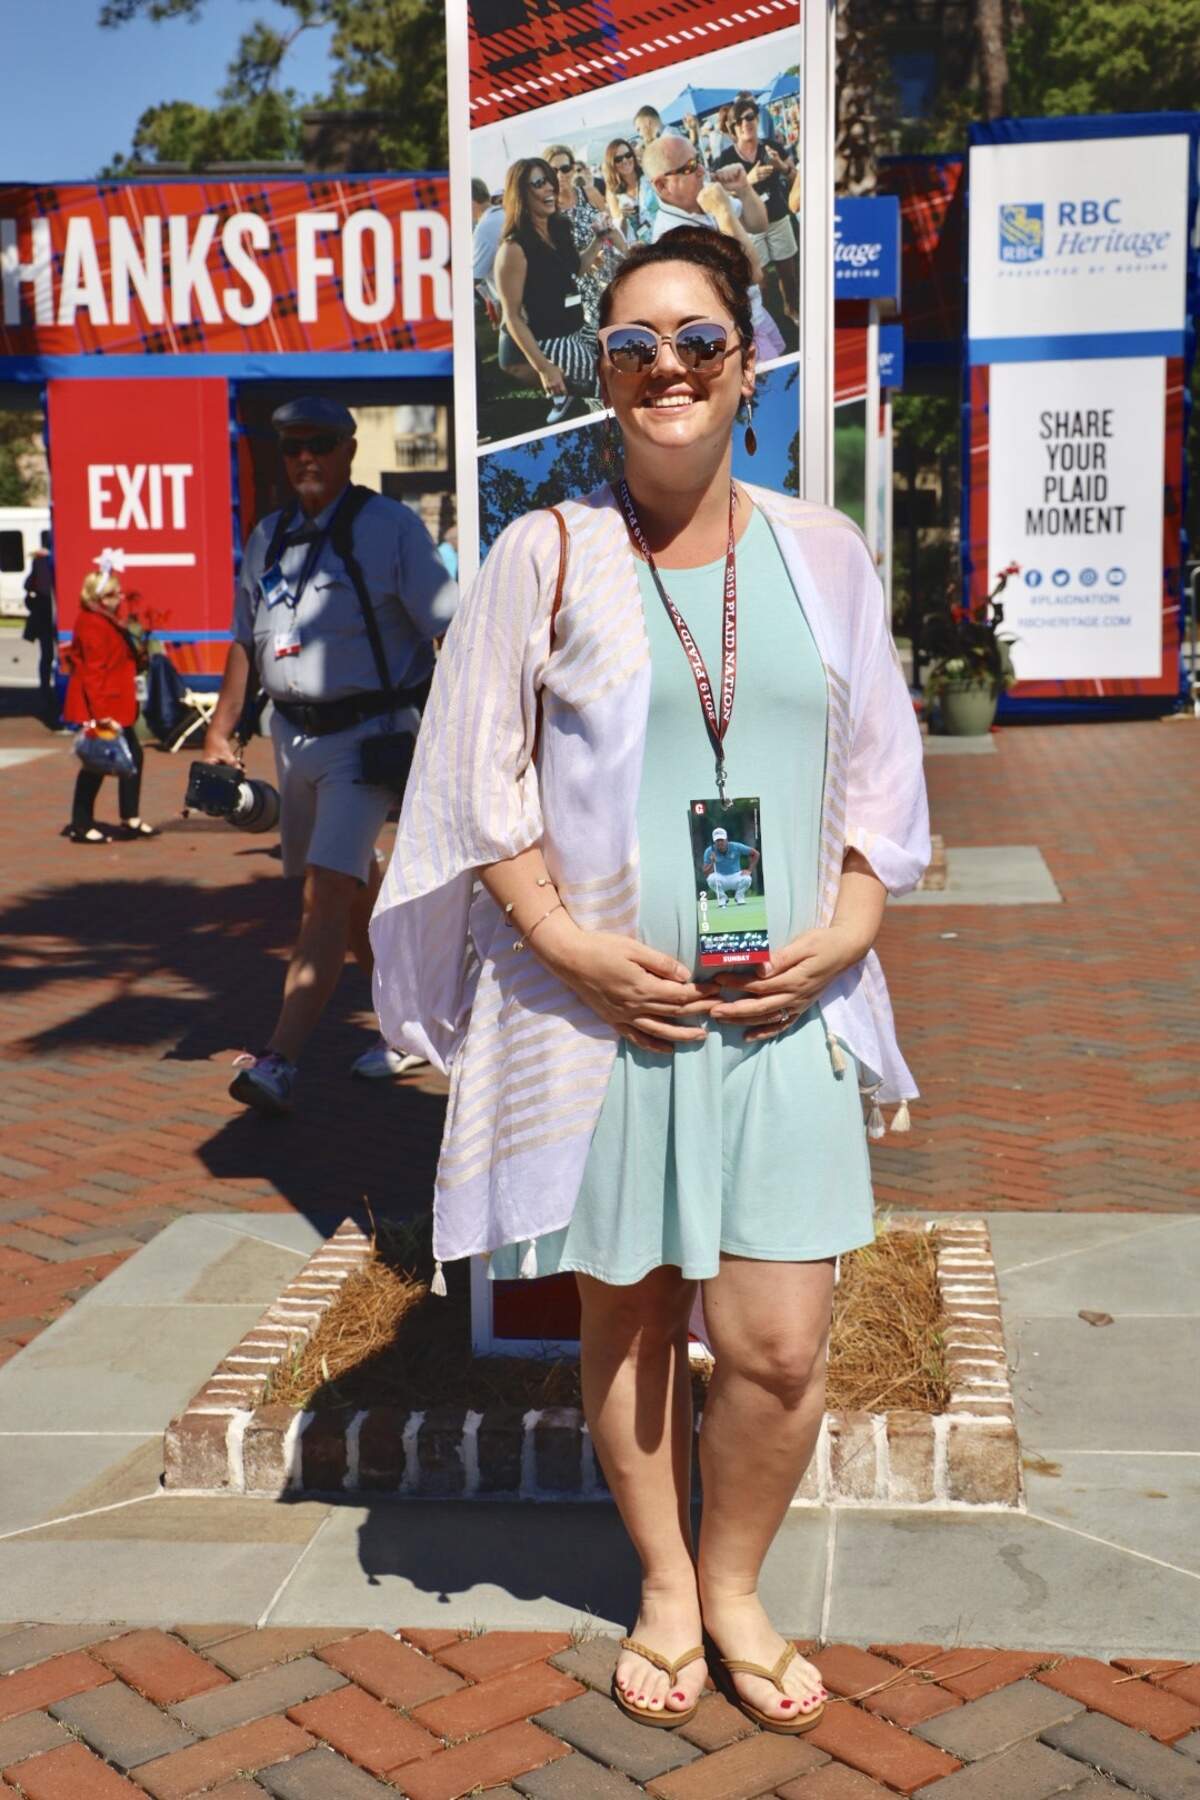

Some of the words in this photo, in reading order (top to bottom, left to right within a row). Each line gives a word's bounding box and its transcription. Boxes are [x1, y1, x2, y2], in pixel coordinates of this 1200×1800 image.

[1058, 199, 1121, 226] RBC
[1056, 228, 1171, 258] Heritage
[1, 211, 271, 327] HANKS
[295, 209, 454, 324] FOR
[1040, 410, 1114, 439] SHARE
[1046, 443, 1106, 471] YOUR
[88, 464, 194, 530] EXIT
[1045, 475, 1108, 503] PLAID
[1025, 506, 1126, 536] MOMENT
[725, 566, 735, 598] 2019
[725, 601, 736, 649] PLAID
[680, 628, 706, 681] PLAID
[700, 683, 717, 720] 2019
[722, 651, 735, 722] NATION
[722, 954, 750, 963] SUNDAY
